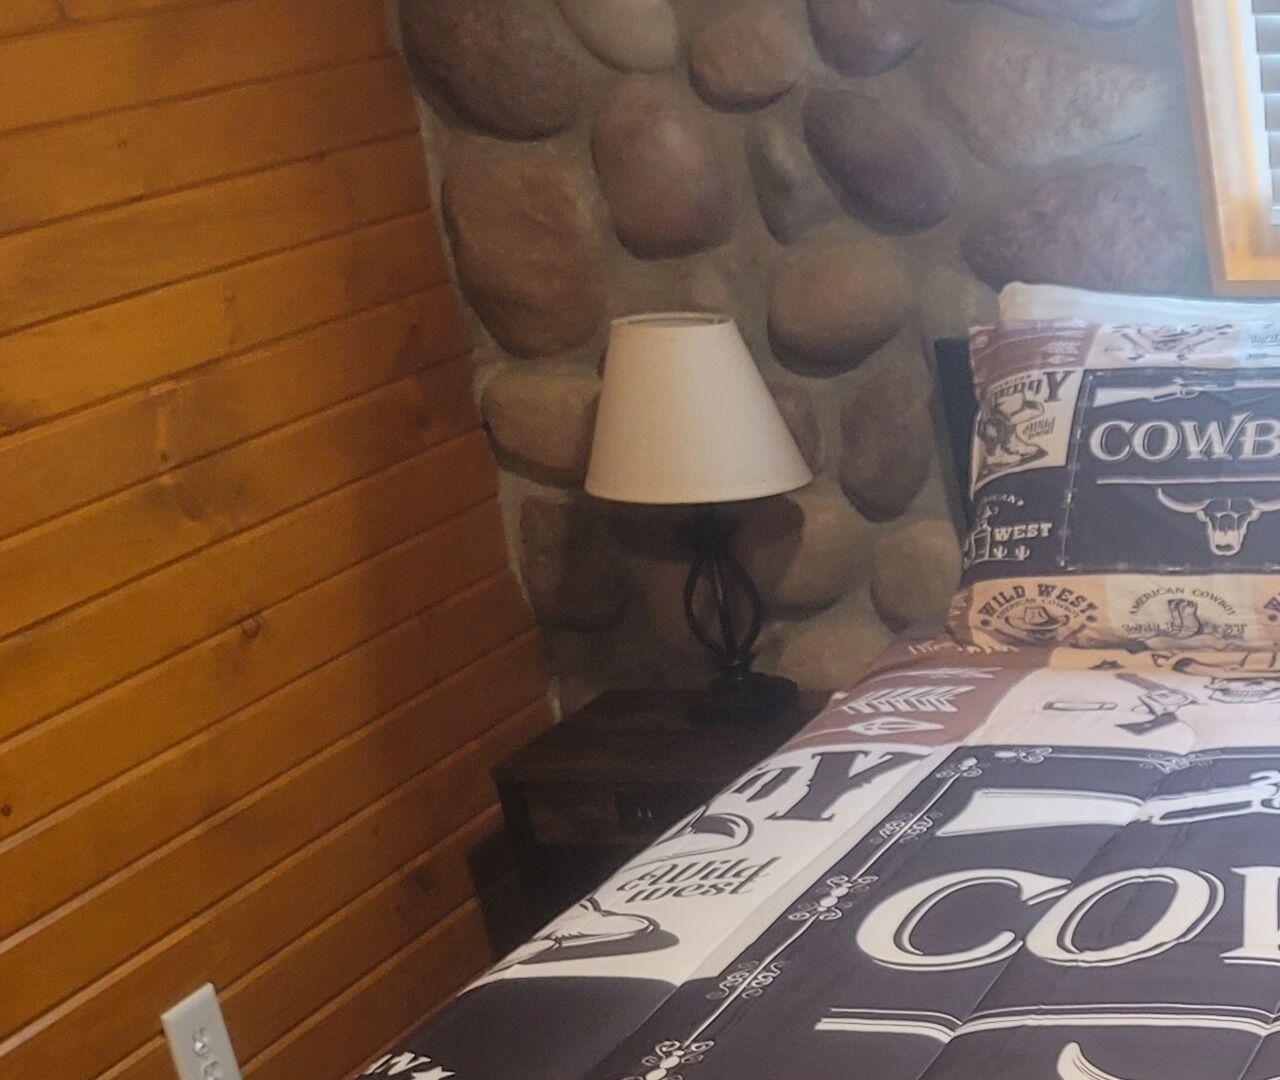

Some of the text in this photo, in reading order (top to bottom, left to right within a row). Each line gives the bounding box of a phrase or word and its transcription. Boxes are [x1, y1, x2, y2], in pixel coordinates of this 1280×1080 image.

[993, 523, 1053, 542] WEST
[978, 584, 1099, 617] WILD WEST
